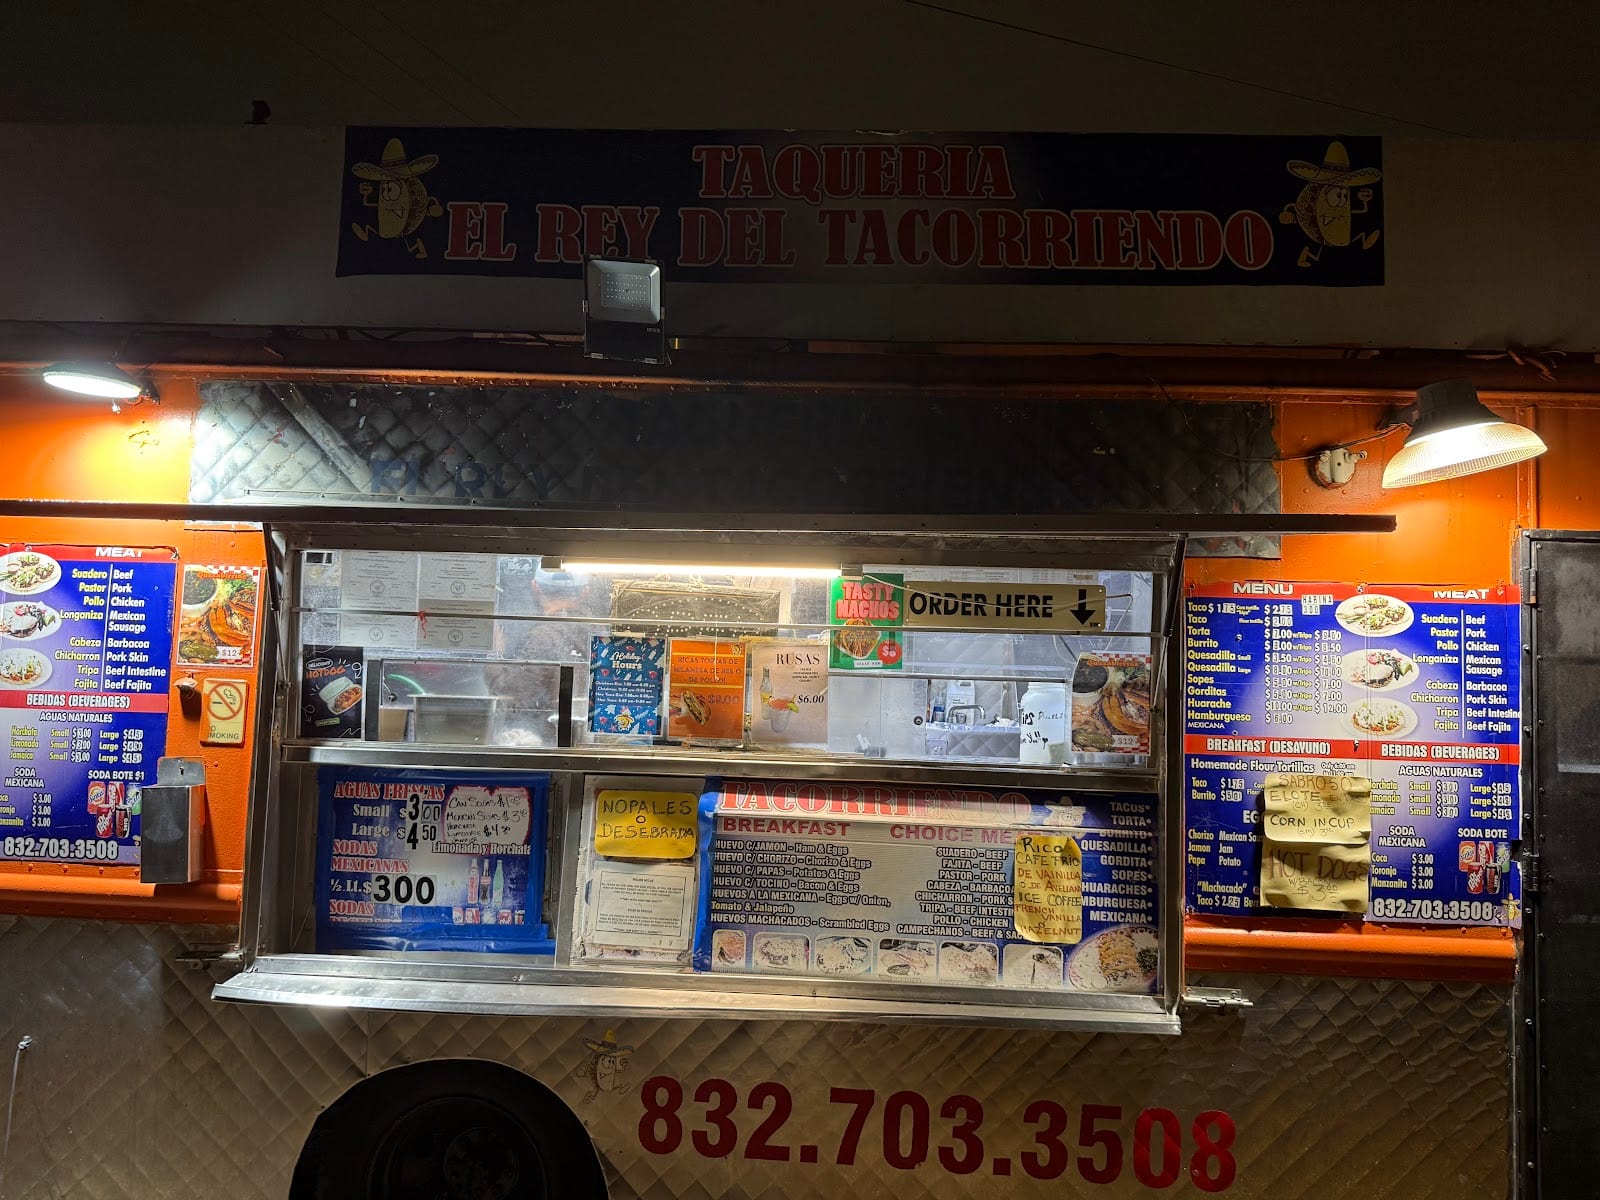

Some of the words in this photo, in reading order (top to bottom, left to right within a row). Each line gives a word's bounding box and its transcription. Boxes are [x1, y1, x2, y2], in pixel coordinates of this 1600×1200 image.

[692, 143, 1016, 205] TAQUERIA
[444, 201, 516, 262] EL
[535, 203, 659, 265] REY
[676, 206, 797, 268] DEL
[818, 207, 1274, 271] TACORRIENDO
[95, 547, 143, 558] MEAT
[72, 569, 107, 579] Suadero
[113, 570, 134, 580] Beef
[79, 583, 106, 592] Pastor
[112, 583, 132, 593] Pork
[842, 582, 894, 600] TASTY
[1233, 583, 1293, 594] MENU
[1434, 589, 1490, 599] MEAT
[83, 596, 104, 606] Pollo
[111, 597, 145, 607] Chicken
[910, 592, 987, 616] ORDER
[996, 595, 1053, 618] HERE
[836, 600, 899, 619] NACHOS
[1188, 602, 1207, 612] Taco
[59, 610, 103, 621] Longaniza
[110, 611, 145, 621] Mexican
[1188, 615, 1207, 623] Taco
[1421, 614, 1458, 624] Suadero
[1466, 615, 1485, 625] Beef
[108, 622, 146, 634] Sausage
[1188, 627, 1210, 635] Torta
[1431, 627, 1458, 637] Pastor
[1466, 629, 1486, 638] Pork
[70, 637, 101, 647] Cabeza
[107, 638, 150, 648] Barbacoa
[1188, 639, 1219, 647] Burrito
[1437, 641, 1458, 649] Pollo
[1466, 642, 1499, 651] Chicken
[54, 650, 100, 661] Chicharron
[106, 652, 127, 661] Pork
[129, 653, 148, 662] Skin
[222, 649, 236, 657] $12
[1188, 650, 1236, 661] Quesadilla
[777, 654, 820, 664] RUSAS
[1412, 653, 1458, 664] Longaniza
[1466, 655, 1501, 664] Mexican
[105, 666, 126, 675] Beef
[128, 667, 166, 676] Intestine
[612, 661, 642, 671] Hours
[1188, 663, 1236, 672] Quesadilla
[1466, 665, 1502, 676] Sausage
[104, 679, 125, 689] Beef
[1188, 674, 1214, 684] Sopes
[1426, 680, 1458, 690] Cabeza
[1466, 681, 1507, 691] Barbacoa
[1188, 686, 1227, 696] Gorditas
[27, 694, 65, 706] BEBIDAS
[69, 695, 130, 708] (BEVERAGES)
[798, 695, 824, 703] $6.00
[1188, 698, 1231, 708] Huarache
[1411, 693, 1458, 704] Chicharron
[1467, 695, 1487, 704] Pork
[1488, 695, 1507, 705] Skin
[40, 712, 67, 721] AGUAS
[68, 714, 113, 723] NATURALES
[1188, 710, 1251, 723] Hamburguesa
[1436, 707, 1459, 718] Tripa
[1467, 708, 1487, 717] Beef
[1434, 720, 1459, 731] Fajita
[1467, 721, 1487, 731] Beef
[1488, 722, 1511, 733] Fajita
[1207, 738, 1266, 752] BREAKFAST
[1270, 740, 1331, 755] (DESAYUNO)
[1382, 744, 1427, 757] BEBIDAS
[1431, 746, 1500, 759] (BEVERAGES)
[1191, 758, 1248, 770] Homemade
[1250, 760, 1275, 771] Flour
[1277, 761, 1314, 772] Tortillas
[15, 768, 36, 777] SODA
[88, 771, 111, 779] SODA
[113, 771, 134, 780] BOTE
[1399, 766, 1431, 776] AGUAS
[1432, 767, 1483, 777] NATURALES
[5, 778, 45, 788] MEXICANA
[1192, 777, 1207, 787] Taco
[1409, 782, 1431, 791] Small
[334, 782, 380, 799] AGUAS
[1192, 790, 1216, 800] Burrito
[721, 781, 1032, 823] TACORRIENDO
[1409, 794, 1431, 803] Small
[353, 804, 390, 817] Small
[602, 800, 692, 815] NOPALES
[1409, 807, 1431, 815] Small
[1271, 815, 1305, 827] CORN
[352, 823, 389, 837] Large
[598, 823, 694, 839] DESEBRADA
[723, 818, 851, 836] BREAKFAST
[1390, 826, 1415, 836] SODA
[890, 824, 973, 841] CHOICE
[1188, 830, 1214, 840] Chorizo
[1219, 831, 1247, 841] Mexican
[1458, 828, 1483, 838] SODA
[1485, 829, 1508, 838] BOTE
[333, 838, 377, 856] SODAS
[715, 840, 744, 850] HUEVO
[1188, 842, 1211, 852] Jamon
[1378, 837, 1426, 847] MEXICANA
[4, 837, 119, 860] 832.703.3508
[937, 847, 977, 858] SUADERO
[985, 851, 1008, 859] BEEF
[1219, 844, 1233, 853] Jam
[714, 853, 744, 862] HUEVO
[1188, 855, 1205, 866] Papa
[1219, 856, 1241, 866] Potato
[1371, 854, 1388, 863] Coca
[331, 856, 409, 873] MEXICANAS
[942, 859, 971, 869] FAJITA
[980, 861, 1002, 870] BEEF
[1269, 849, 1312, 879] HOT
[1315, 856, 1368, 883] DOGS
[714, 865, 743, 875] HUEVO
[1017, 868, 1032, 879] DE
[1371, 865, 1397, 877] Toronja
[939, 870, 973, 880] PASTOR
[981, 873, 1006, 882] PORK
[713, 877, 742, 887] HUEVO
[927, 880, 961, 891] CABEZA
[1371, 878, 1407, 888] Manzanita
[712, 889, 747, 899] HUEVOS
[770, 892, 818, 902] MEXICANA
[915, 891, 973, 903] CHICHARRON
[1019, 892, 1042, 903] ICE
[1048, 894, 1081, 906] COFFEE
[1197, 895, 1213, 905] Taco
[329, 899, 375, 916] SODAS
[920, 903, 946, 913] TRIPA
[1015, 904, 1054, 914] FRENCH
[1373, 898, 1494, 921] 832.703.3508
[711, 913, 746, 923] HUEVOS
[749, 915, 810, 926] MACHACADOS
[819, 918, 866, 930] Scrambled
[933, 915, 961, 925] POLLO
[970, 917, 1009, 927] CHICKEN
[1041, 914, 1081, 922] VANILLA
[897, 925, 963, 936] CAMPECHANOS
[971, 929, 994, 938] BEEF
[638, 1075, 1237, 1192] 832.703.3508
